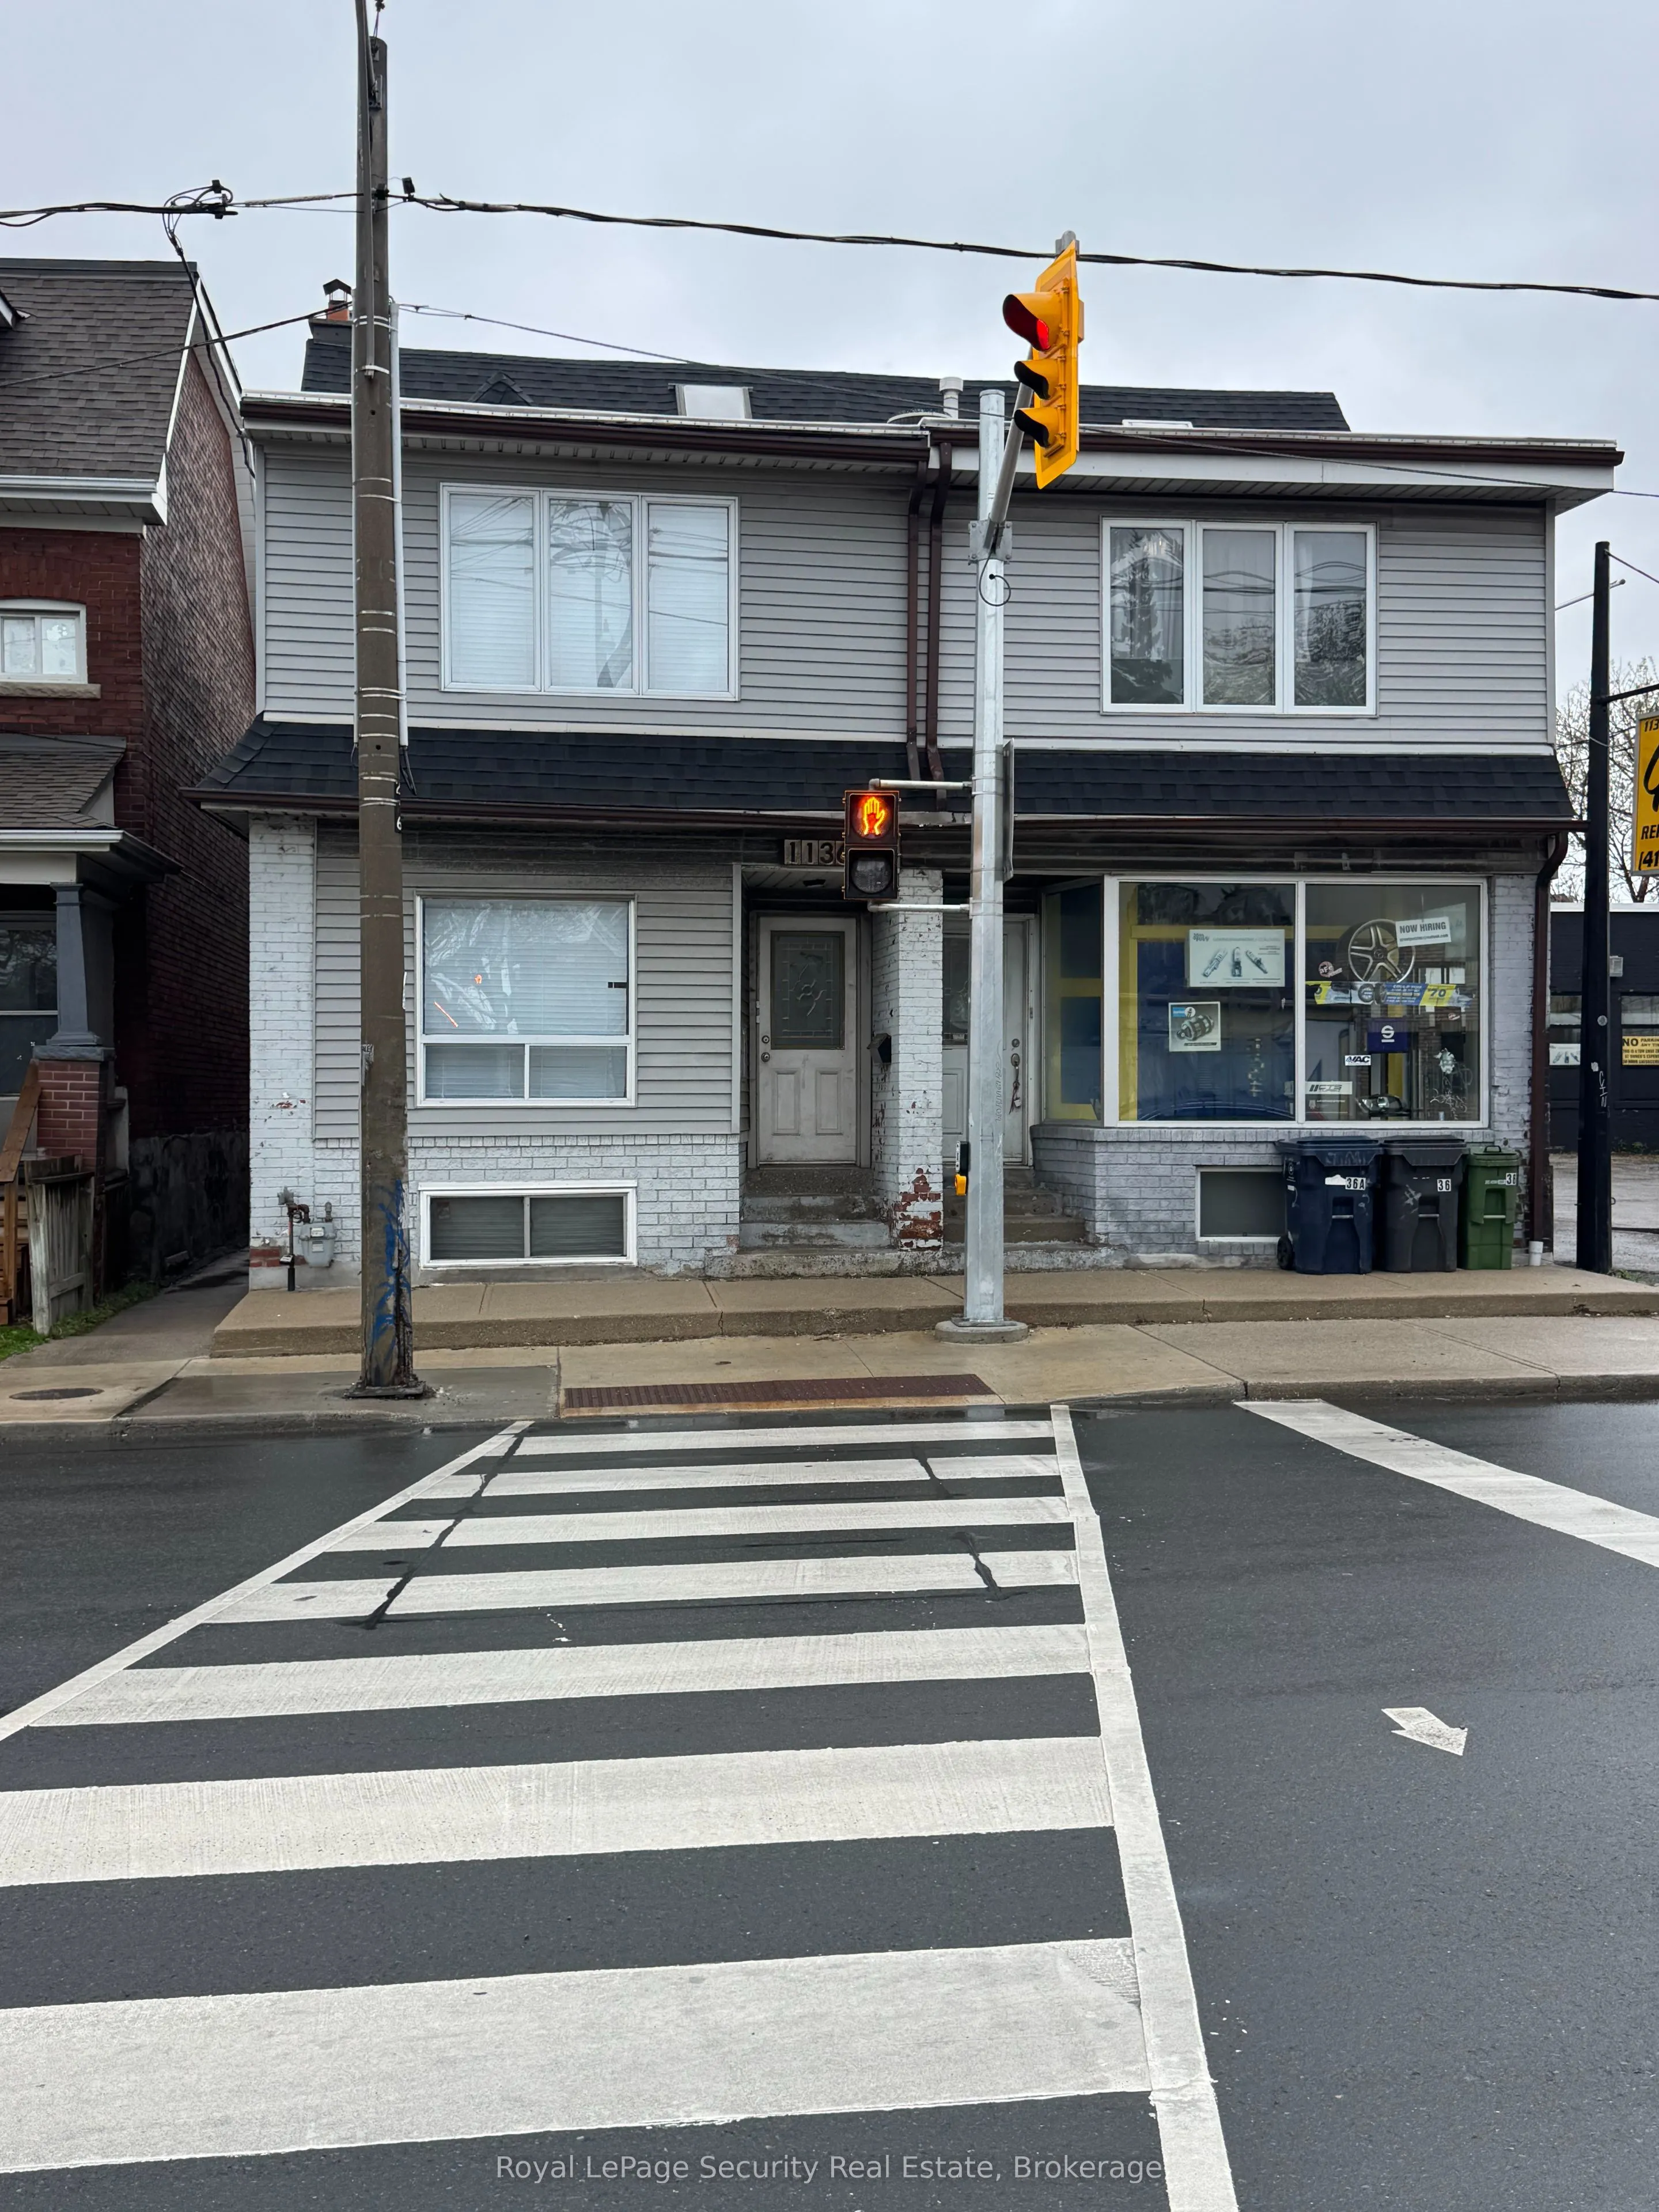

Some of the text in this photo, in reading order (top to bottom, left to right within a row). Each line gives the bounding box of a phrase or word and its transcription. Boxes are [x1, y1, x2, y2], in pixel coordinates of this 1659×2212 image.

[1399, 922, 1446, 934] NOW HIRING
[1622, 1037, 1639, 1047] NO
[1346, 1177, 1365, 1190] 36A
[1438, 1180, 1450, 1191] 36
